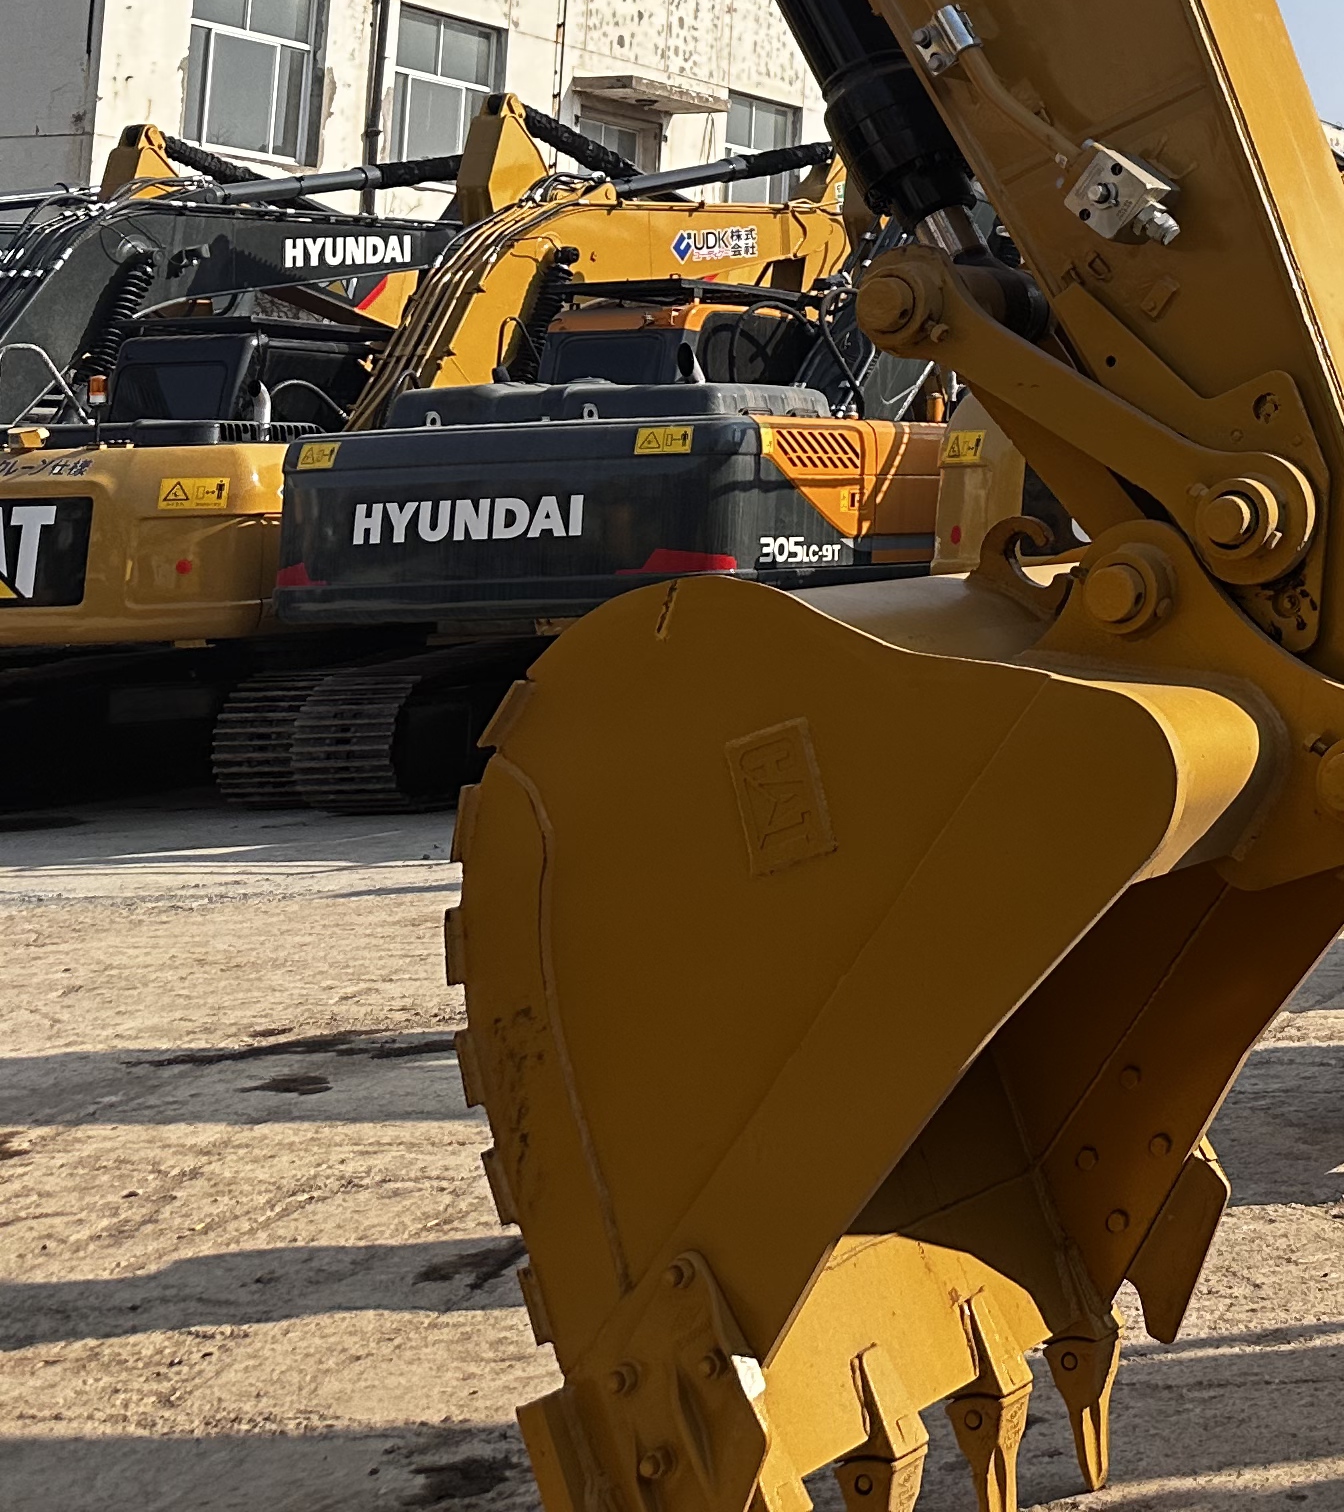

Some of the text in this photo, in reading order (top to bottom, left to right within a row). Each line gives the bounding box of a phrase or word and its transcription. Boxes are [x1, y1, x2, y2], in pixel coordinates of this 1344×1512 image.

[285, 235, 411, 268] HYUNDAI
[693, 230, 731, 250] UDK
[353, 494, 584, 545] HYUNDAI
